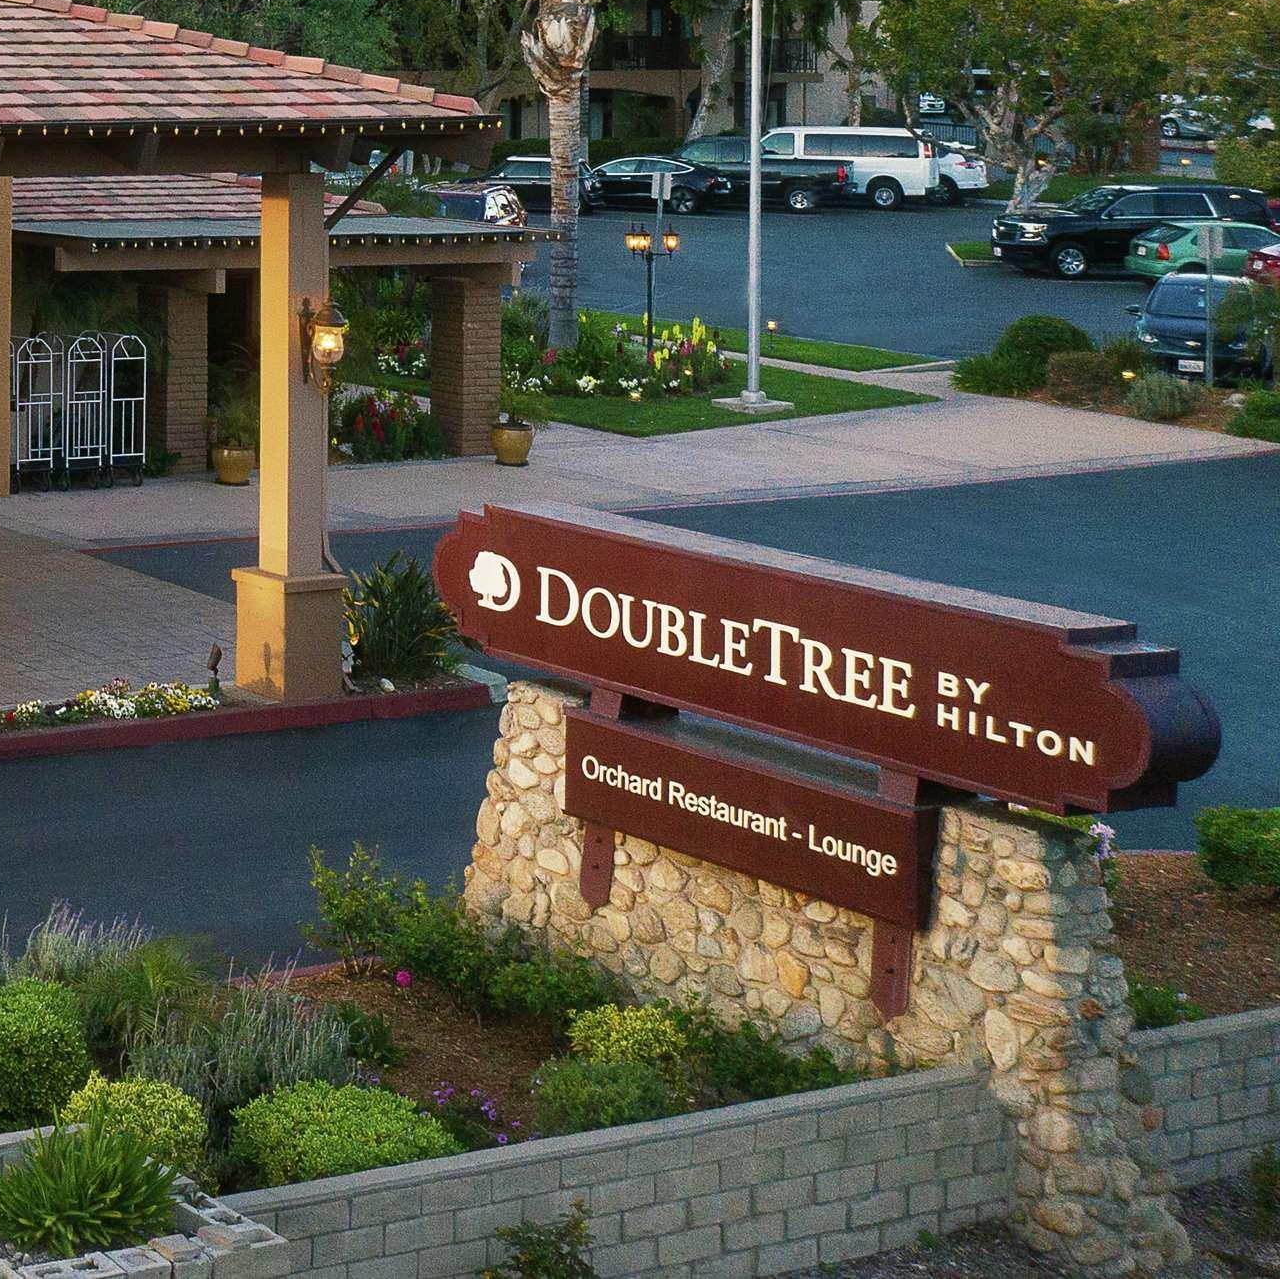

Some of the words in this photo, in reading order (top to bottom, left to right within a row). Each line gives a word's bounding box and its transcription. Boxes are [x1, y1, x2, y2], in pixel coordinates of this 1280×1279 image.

[536, 566, 916, 719] DOUBLETREE
[937, 671, 990, 705] BY
[936, 703, 1096, 766] HILTON
[581, 755, 662, 801] Orchard
[668, 781, 788, 841] Restaurant
[808, 824, 898, 877] Lounge
